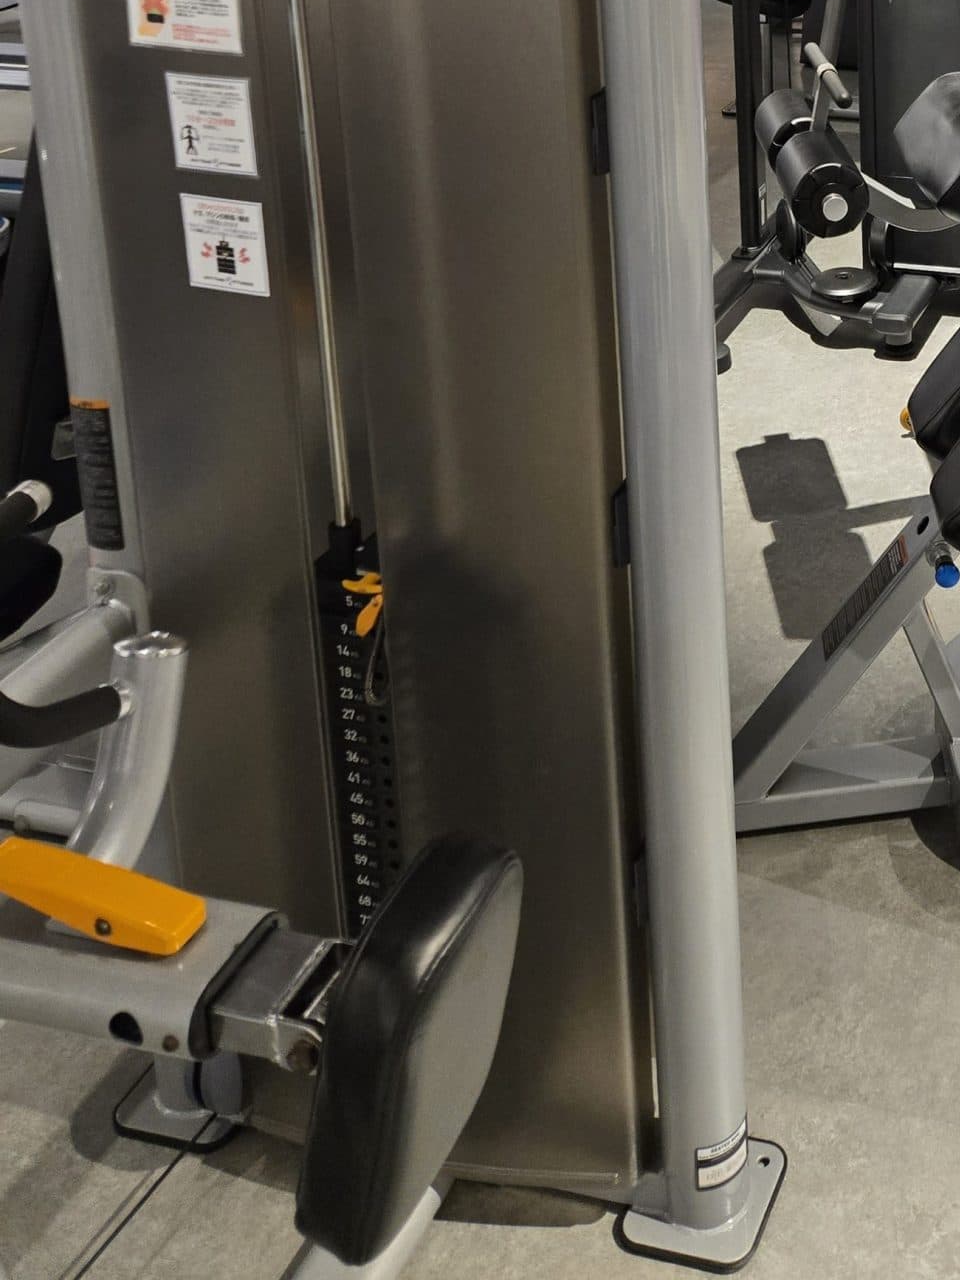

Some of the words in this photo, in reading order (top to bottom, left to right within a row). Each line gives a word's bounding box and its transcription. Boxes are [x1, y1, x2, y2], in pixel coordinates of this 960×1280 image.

[345, 595, 354, 607] 5
[340, 623, 349, 635] 9
[336, 644, 350, 657] 14
[338, 665, 353, 678] 18
[340, 687, 354, 700] 23
[341, 708, 356, 721] 27
[344, 728, 358, 742] 32
[351, 812, 365, 826] 50
[353, 833, 367, 846] 55
[354, 853, 368, 866] 59
[357, 874, 370, 887] 64
[358, 895, 372, 907] 68
